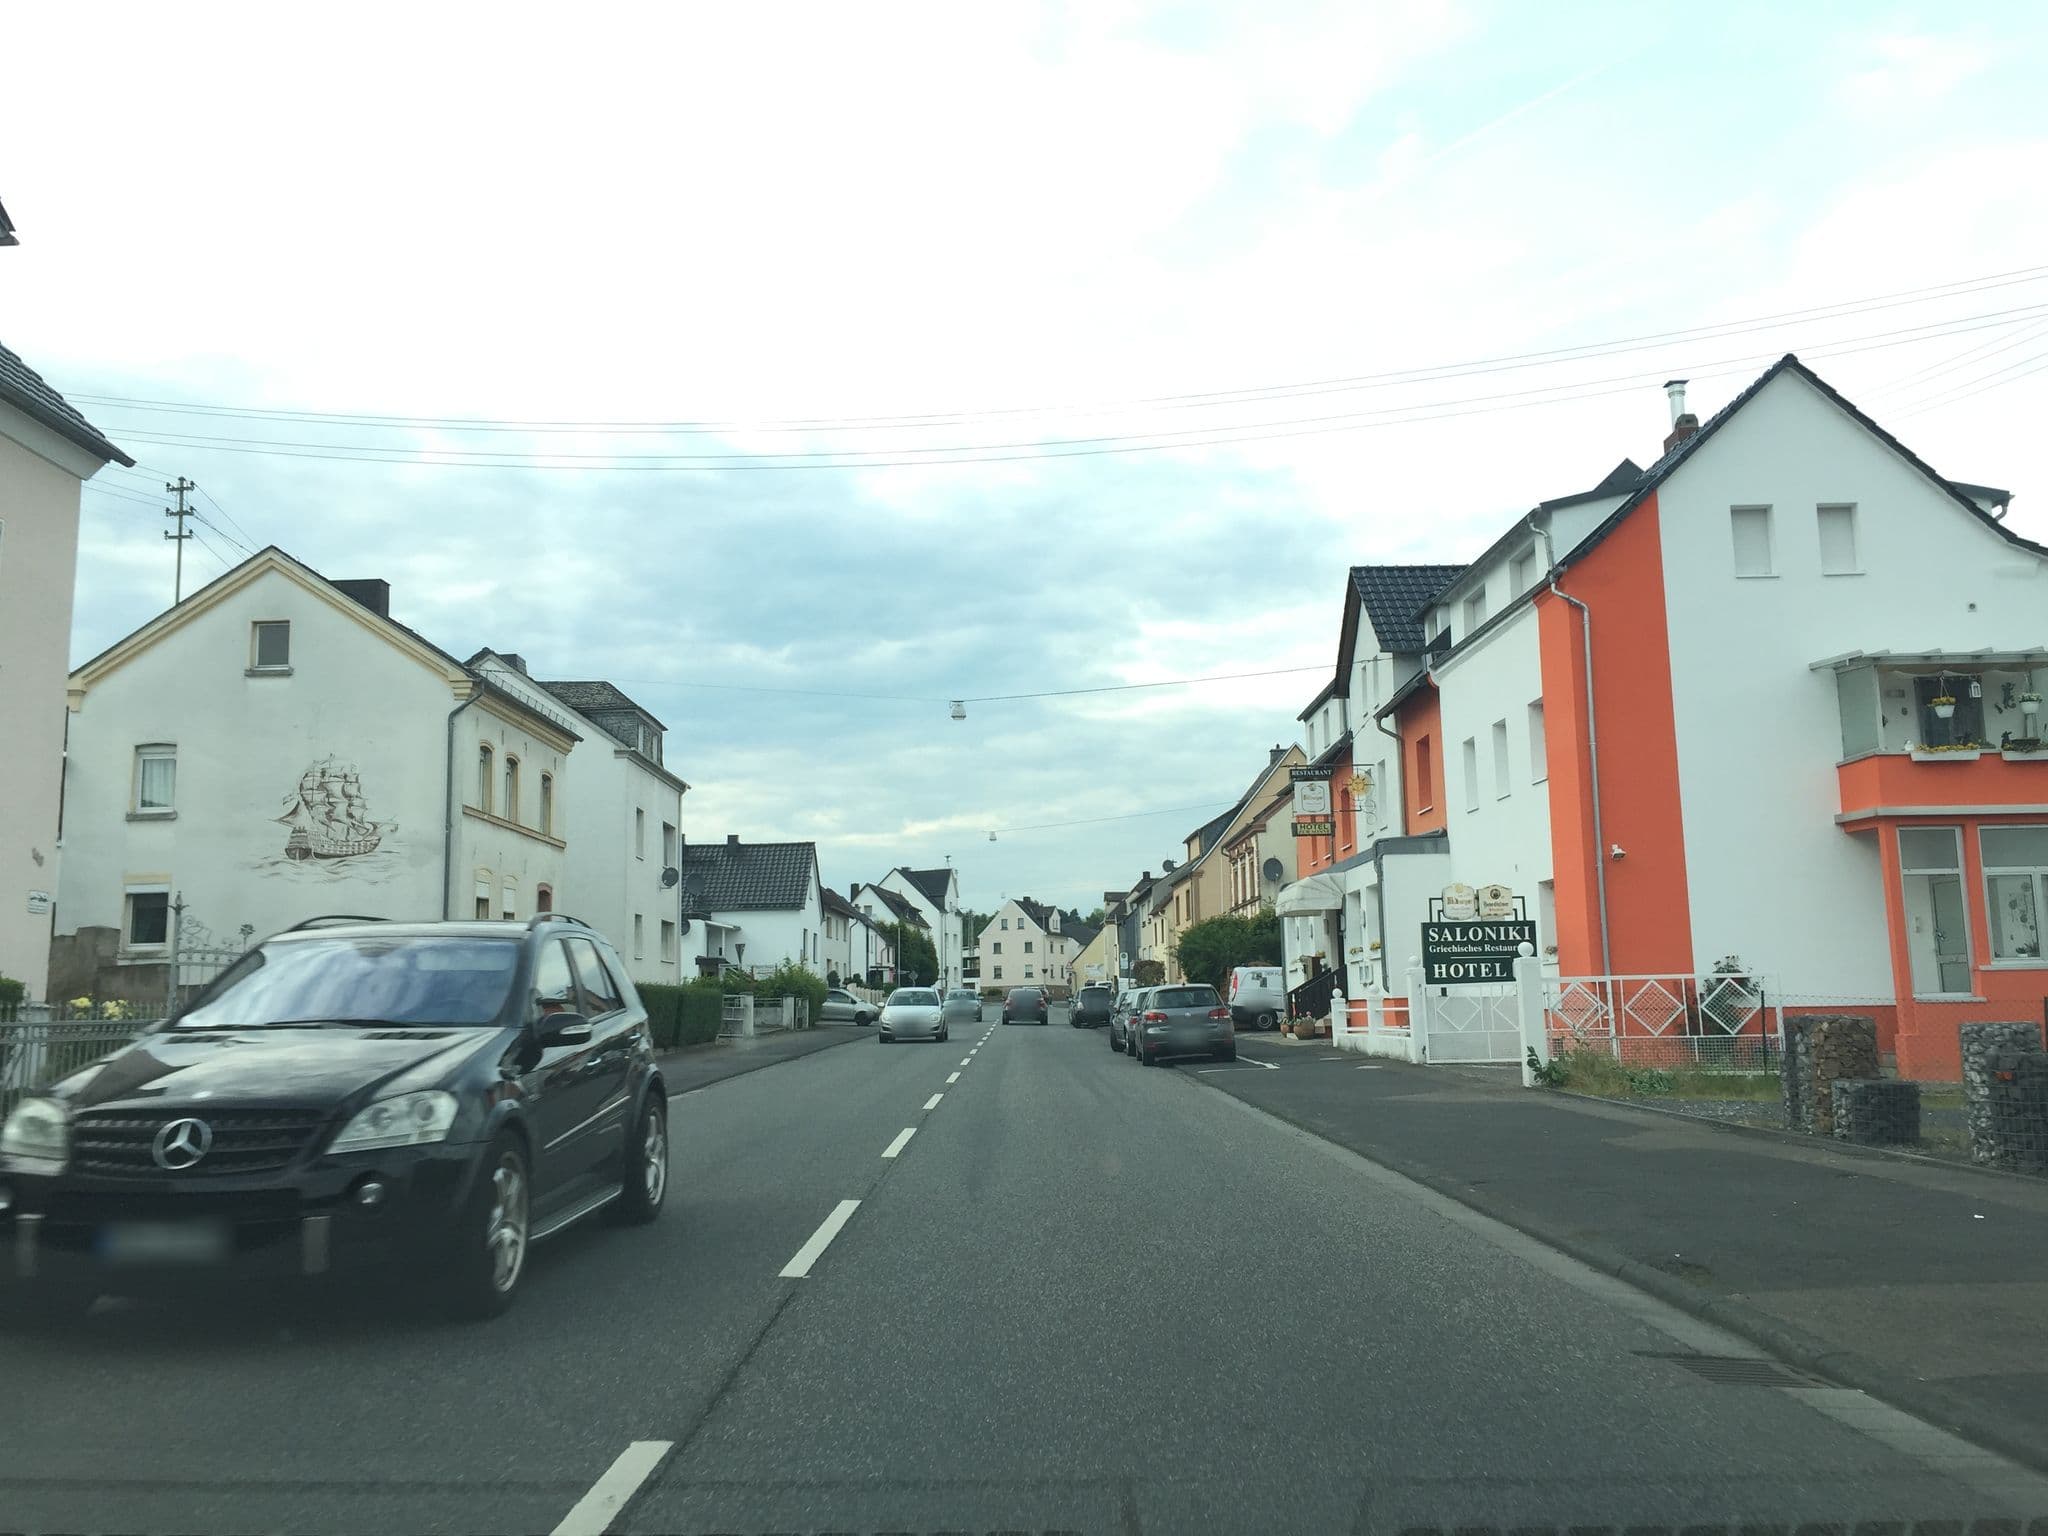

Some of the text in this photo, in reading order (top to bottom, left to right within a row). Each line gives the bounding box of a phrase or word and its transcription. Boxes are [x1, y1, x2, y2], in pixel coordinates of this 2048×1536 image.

[1429, 926, 1531, 942] SALONIKI
[1429, 943, 1518, 953] Griechisches Restaur
[1433, 963, 1507, 978] HOTEL
